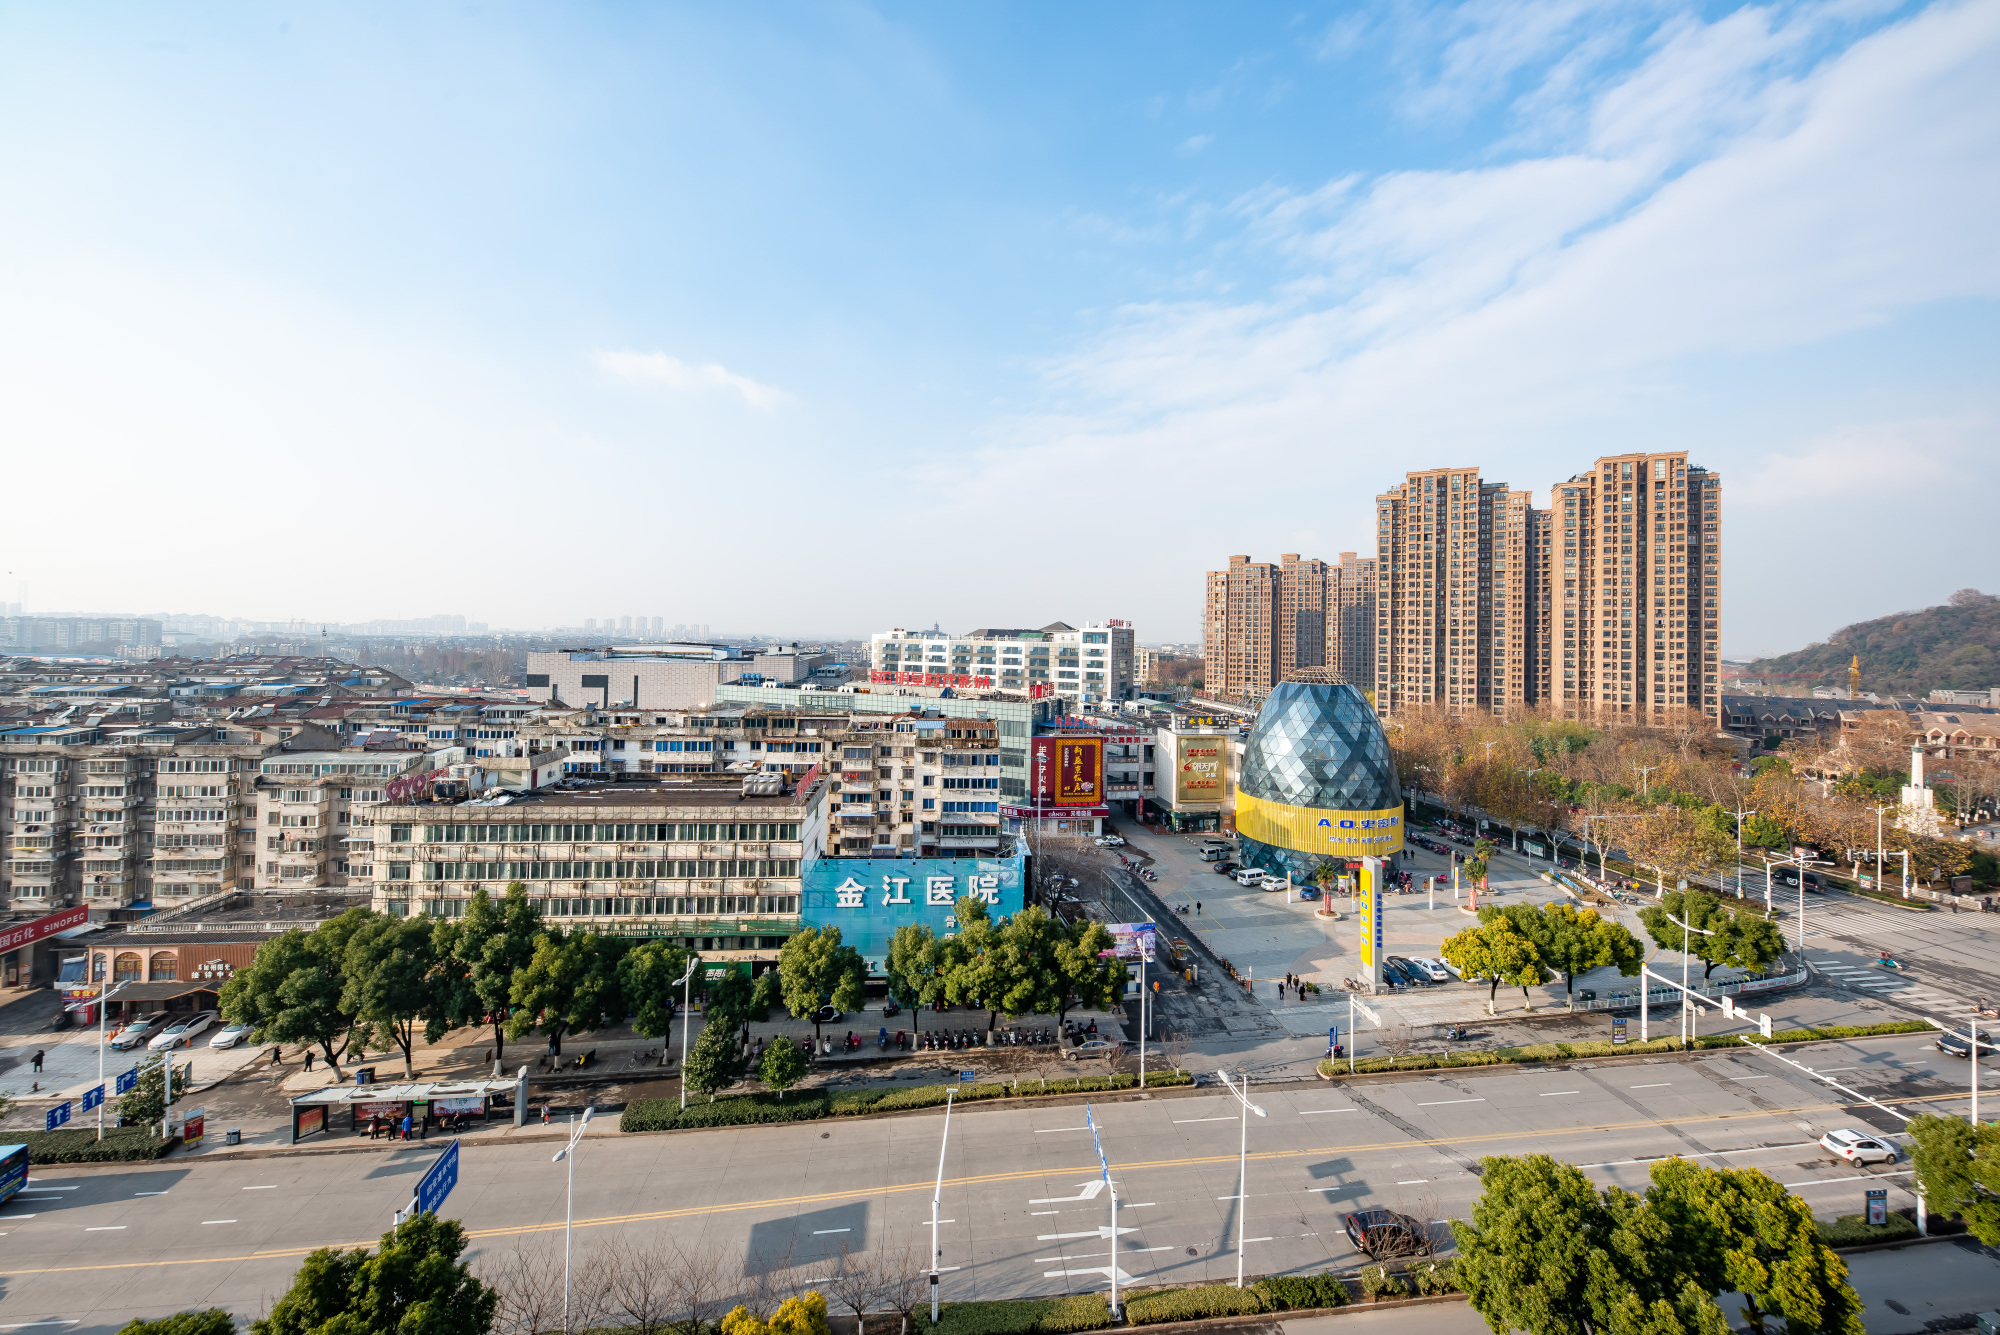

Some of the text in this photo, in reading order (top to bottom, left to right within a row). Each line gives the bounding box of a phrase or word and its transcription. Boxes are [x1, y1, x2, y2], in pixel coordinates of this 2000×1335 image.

[895, 671, 990, 690] 明星时代影城
[386, 774, 426, 800] OYO
[1317, 816, 1399, 829] A.O.史密斯
[834, 874, 999, 908] 金江医院
[44, 912, 84, 933] SINOPEC
